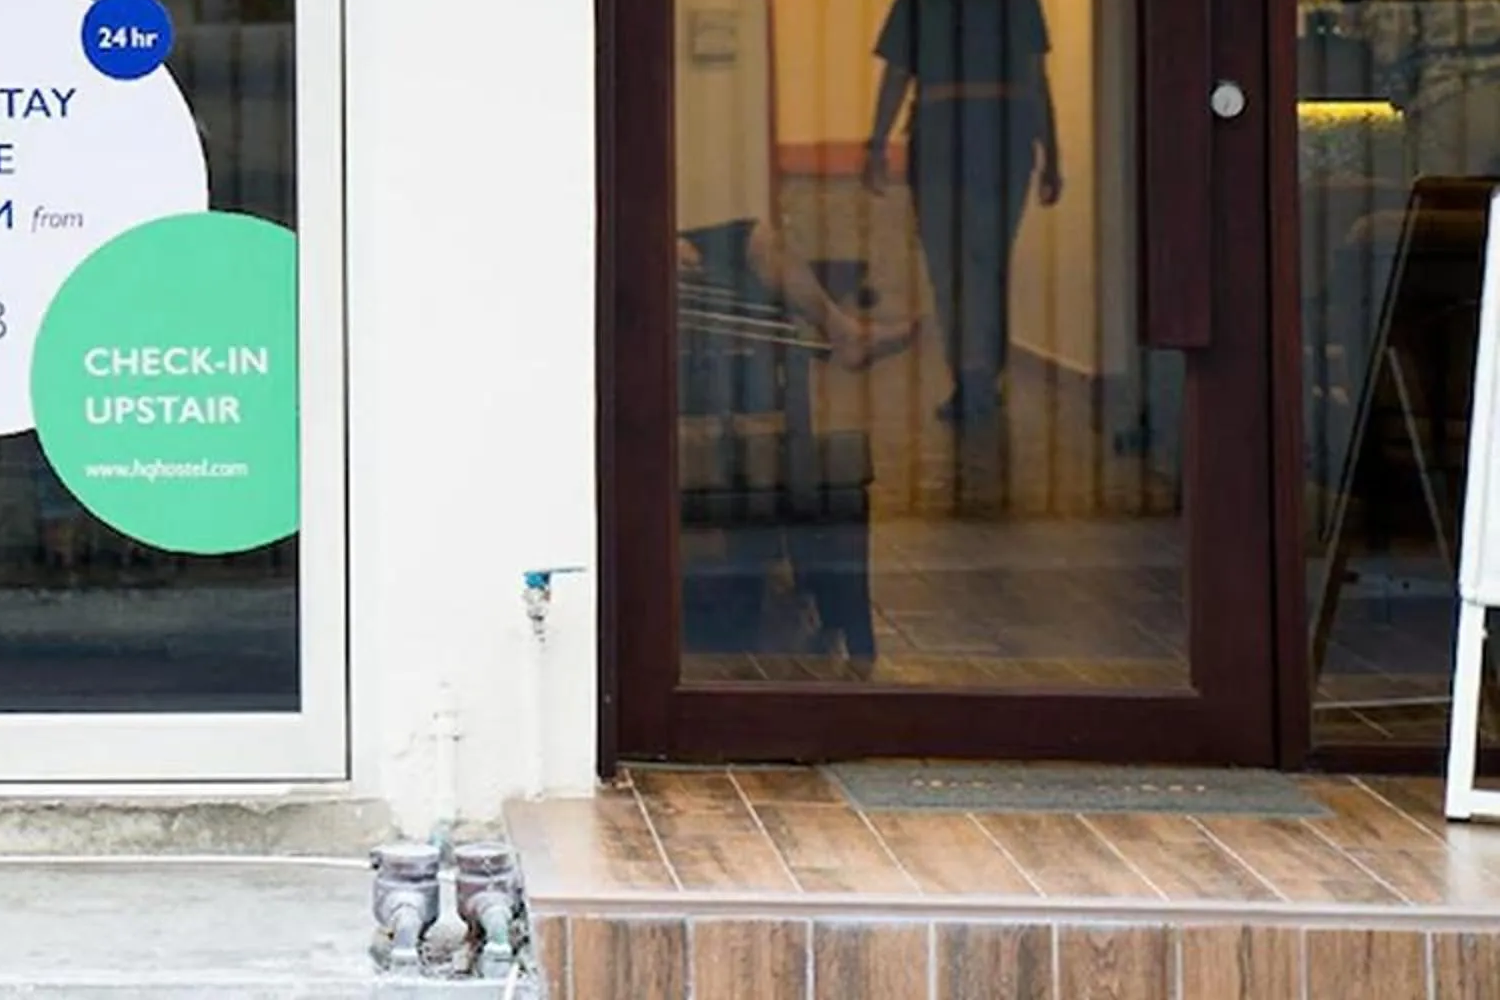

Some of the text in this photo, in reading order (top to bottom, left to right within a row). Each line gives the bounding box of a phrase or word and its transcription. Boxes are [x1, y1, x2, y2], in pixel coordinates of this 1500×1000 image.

[98, 26, 158, 49] 24 hr
[30, 205, 84, 233] from
[84, 346, 268, 376] CHECK-IN
[85, 396, 241, 425] UPSTAIR
[85, 458, 248, 483] www.hqhostel.com
